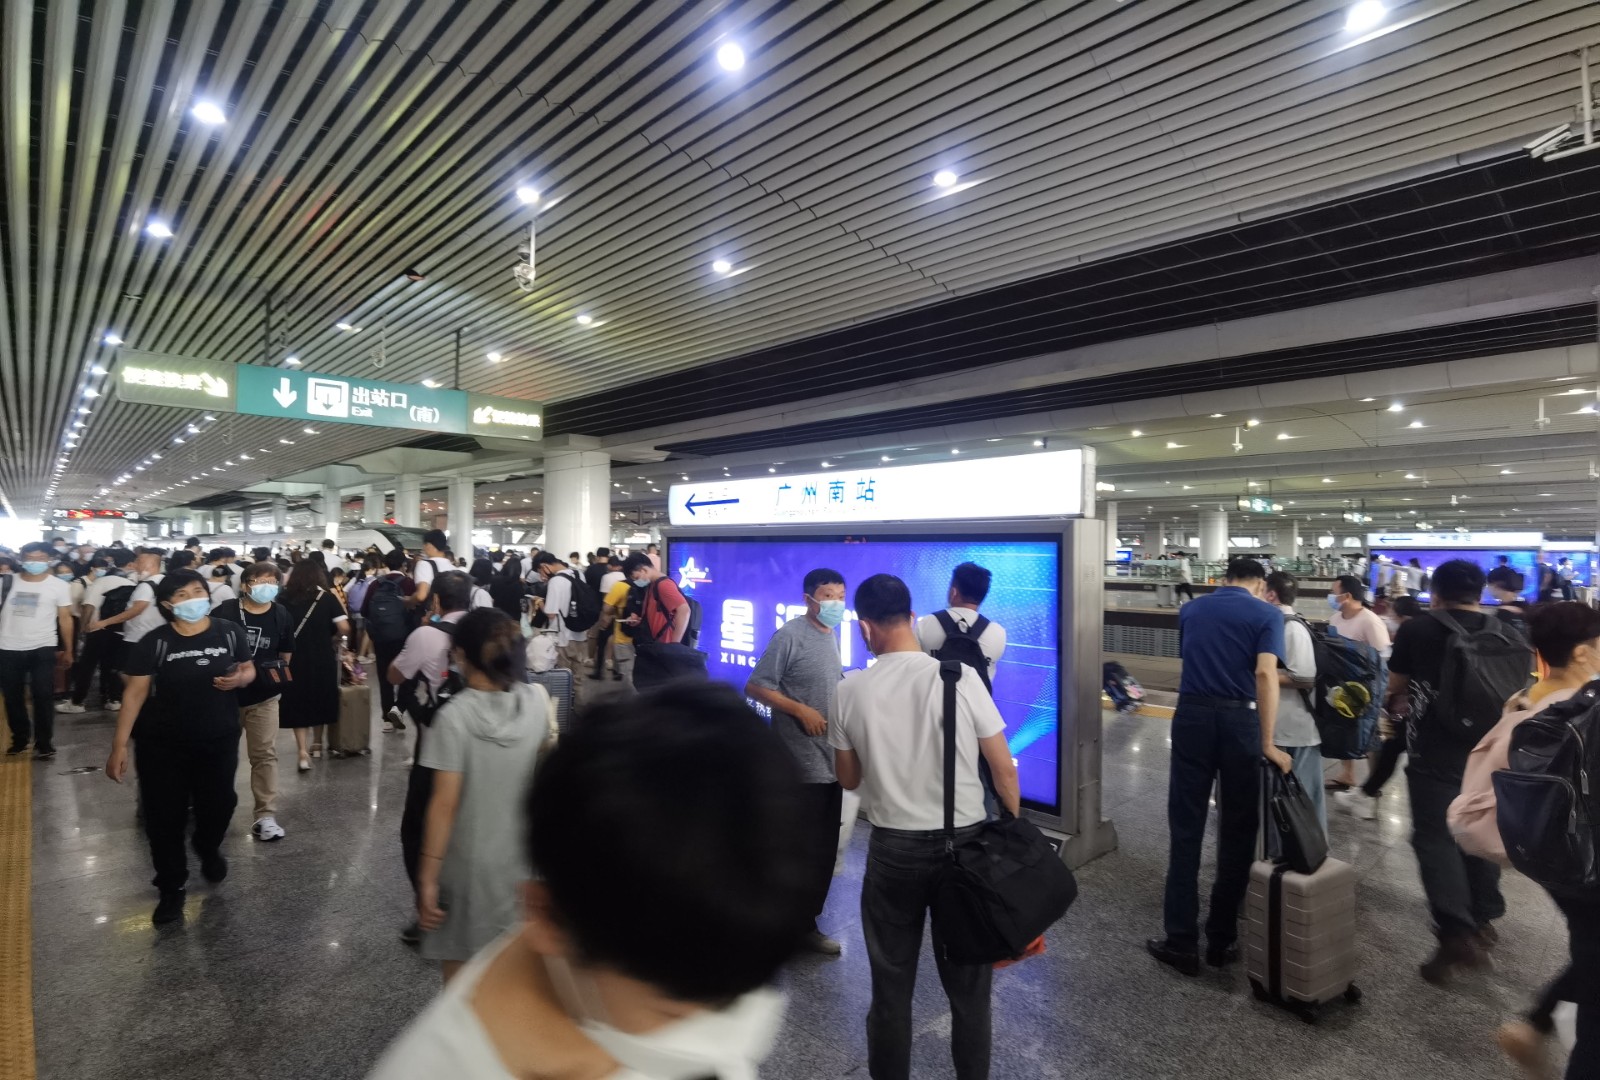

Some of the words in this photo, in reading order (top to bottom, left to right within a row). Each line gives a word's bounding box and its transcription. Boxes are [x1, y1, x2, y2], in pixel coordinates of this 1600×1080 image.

[351, 386, 408, 409] 出站口
[775, 476, 876, 506] 广州南站
